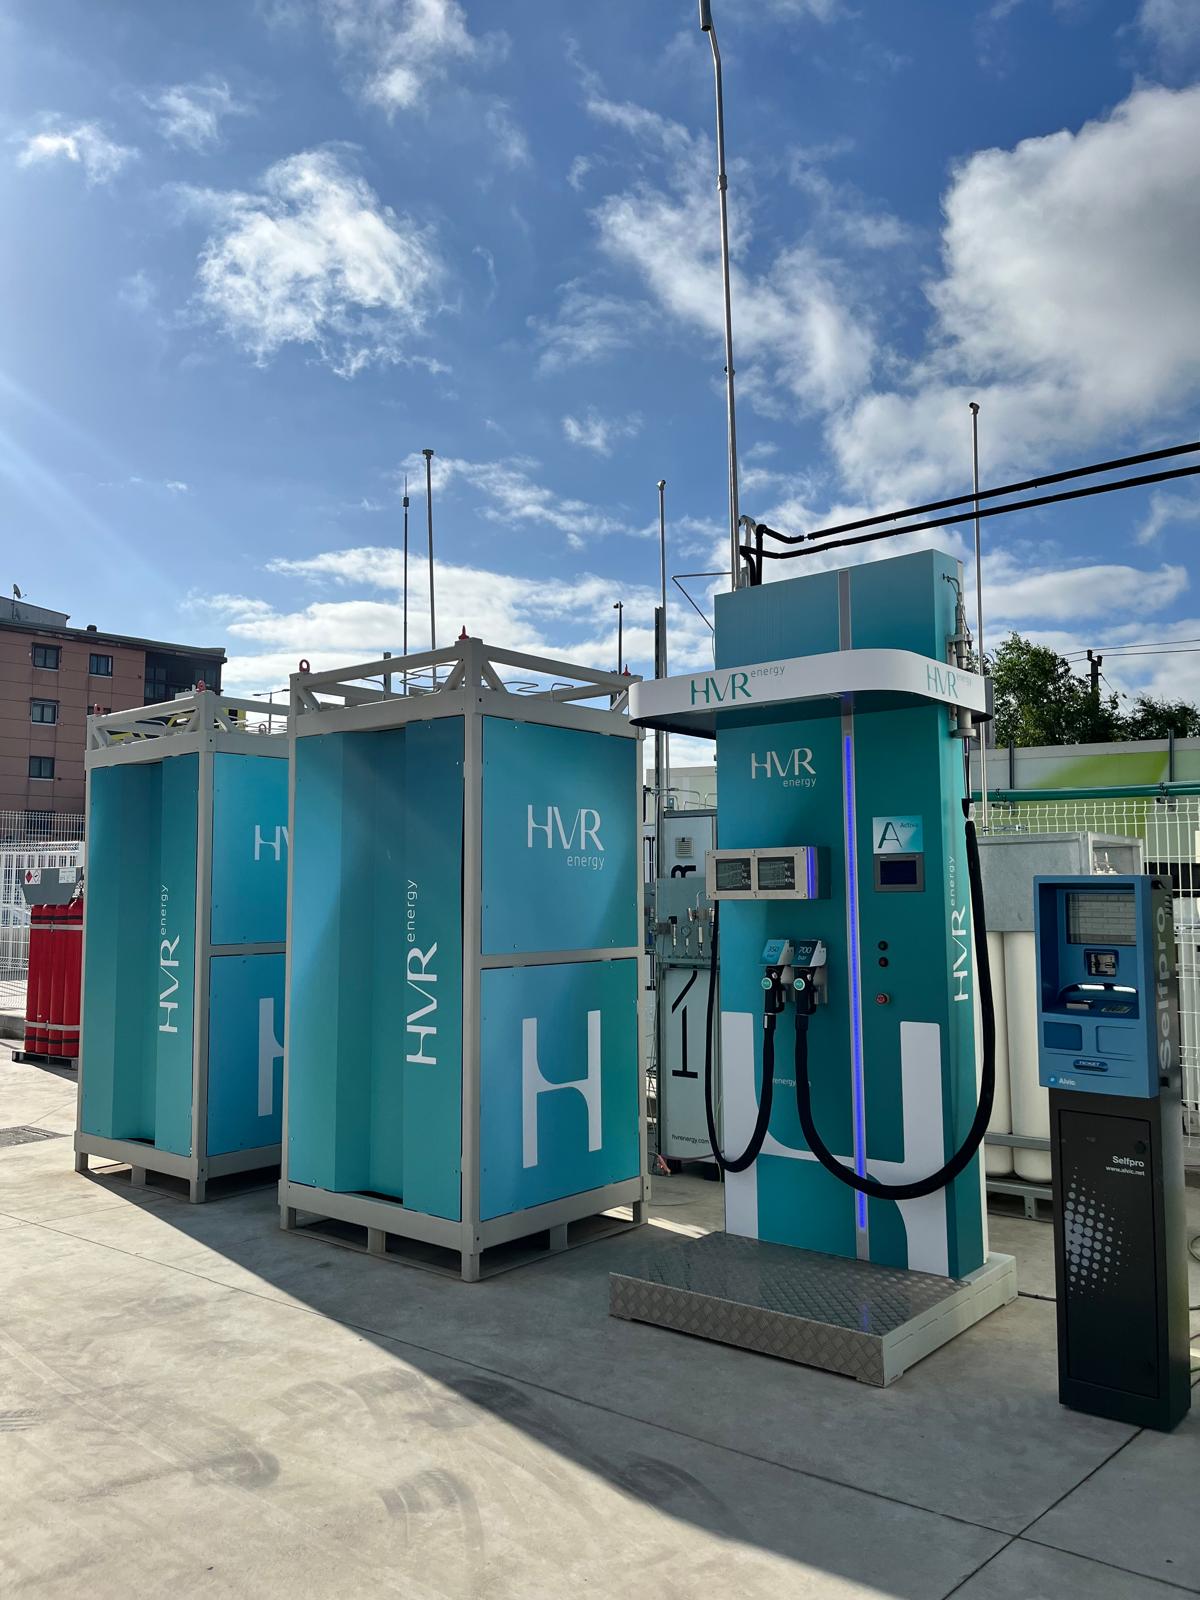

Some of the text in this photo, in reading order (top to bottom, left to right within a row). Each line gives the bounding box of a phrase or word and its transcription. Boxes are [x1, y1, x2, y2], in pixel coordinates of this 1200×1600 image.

[690, 665, 785, 705] HVR energy
[927, 664, 959, 698] HVR
[751, 748, 817, 779] HVR
[783, 778, 817, 788] energy
[527, 804, 604, 851] HVR
[878, 821, 903, 849] A
[567, 855, 605, 870] energy
[948, 855, 969, 1001] energy HVR
[159, 884, 180, 1033] energy HVR
[798, 946, 812, 954] 700
[406, 879, 438, 1066] energy HVR
[1157, 906, 1172, 1071] Selfpro
[522, 1009, 602, 1169] H
[1112, 1155, 1145, 1168] Selfpro
